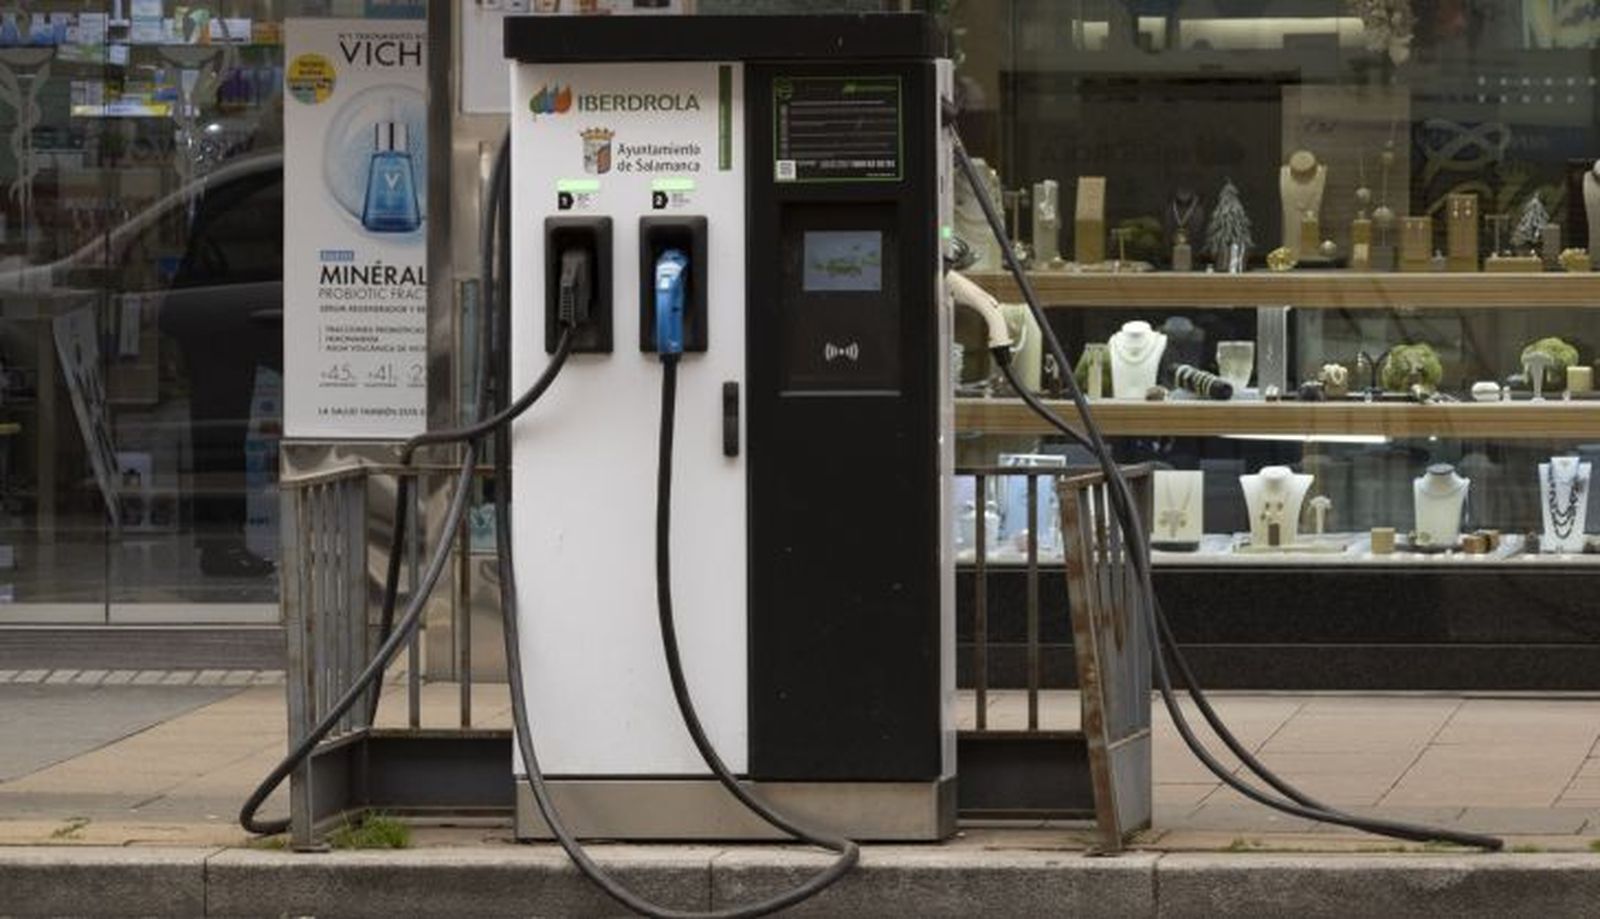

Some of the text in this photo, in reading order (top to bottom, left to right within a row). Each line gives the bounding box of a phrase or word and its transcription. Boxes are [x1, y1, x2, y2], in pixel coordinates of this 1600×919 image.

[340, 41, 421, 66] VICH
[578, 94, 700, 111] IBERDROLA
[617, 143, 701, 158] Ayuntamiento
[617, 158, 701, 173] de Salamanca
[384, 172, 401, 189] V
[319, 259, 427, 286] MINÉRAL
[318, 287, 386, 300] PROBIOTIC
